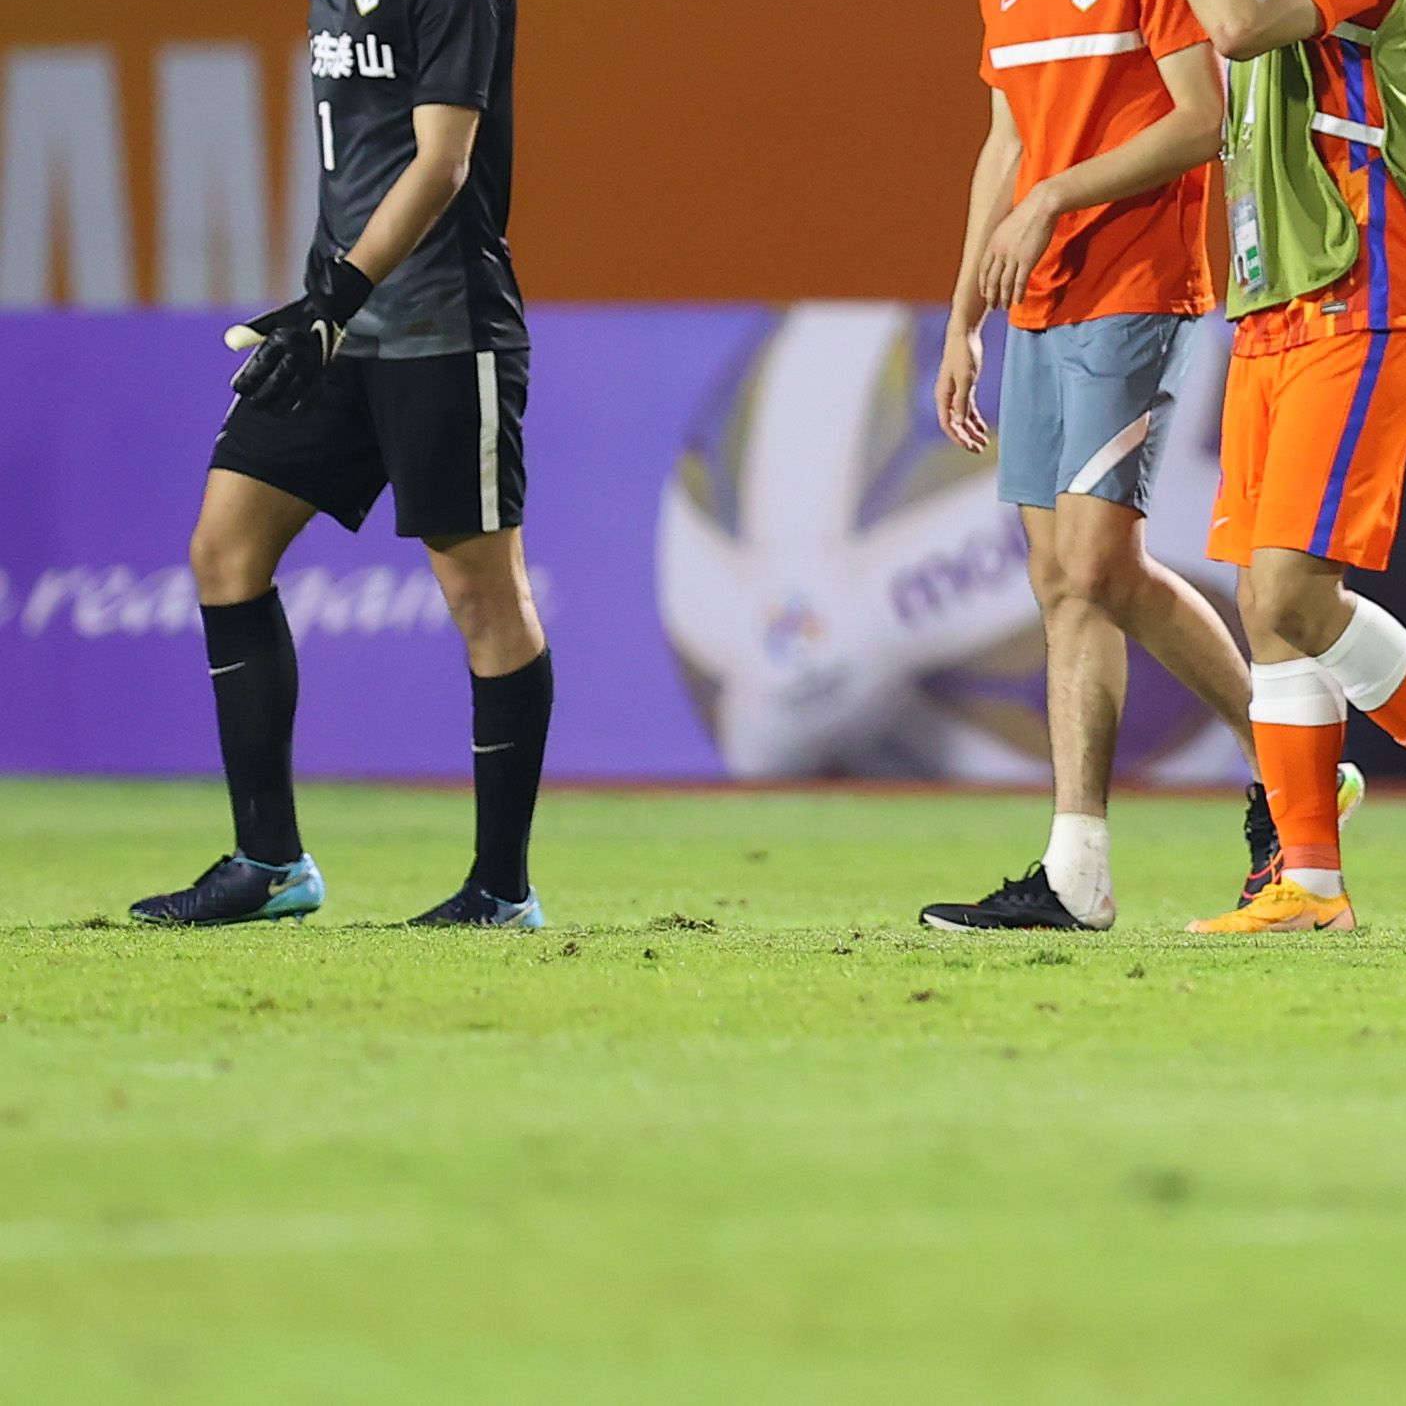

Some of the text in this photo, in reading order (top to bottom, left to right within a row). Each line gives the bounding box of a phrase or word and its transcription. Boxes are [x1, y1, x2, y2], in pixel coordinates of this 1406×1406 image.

[309, 30, 396, 79] 东泰山
[318, 100, 335, 171] 1
